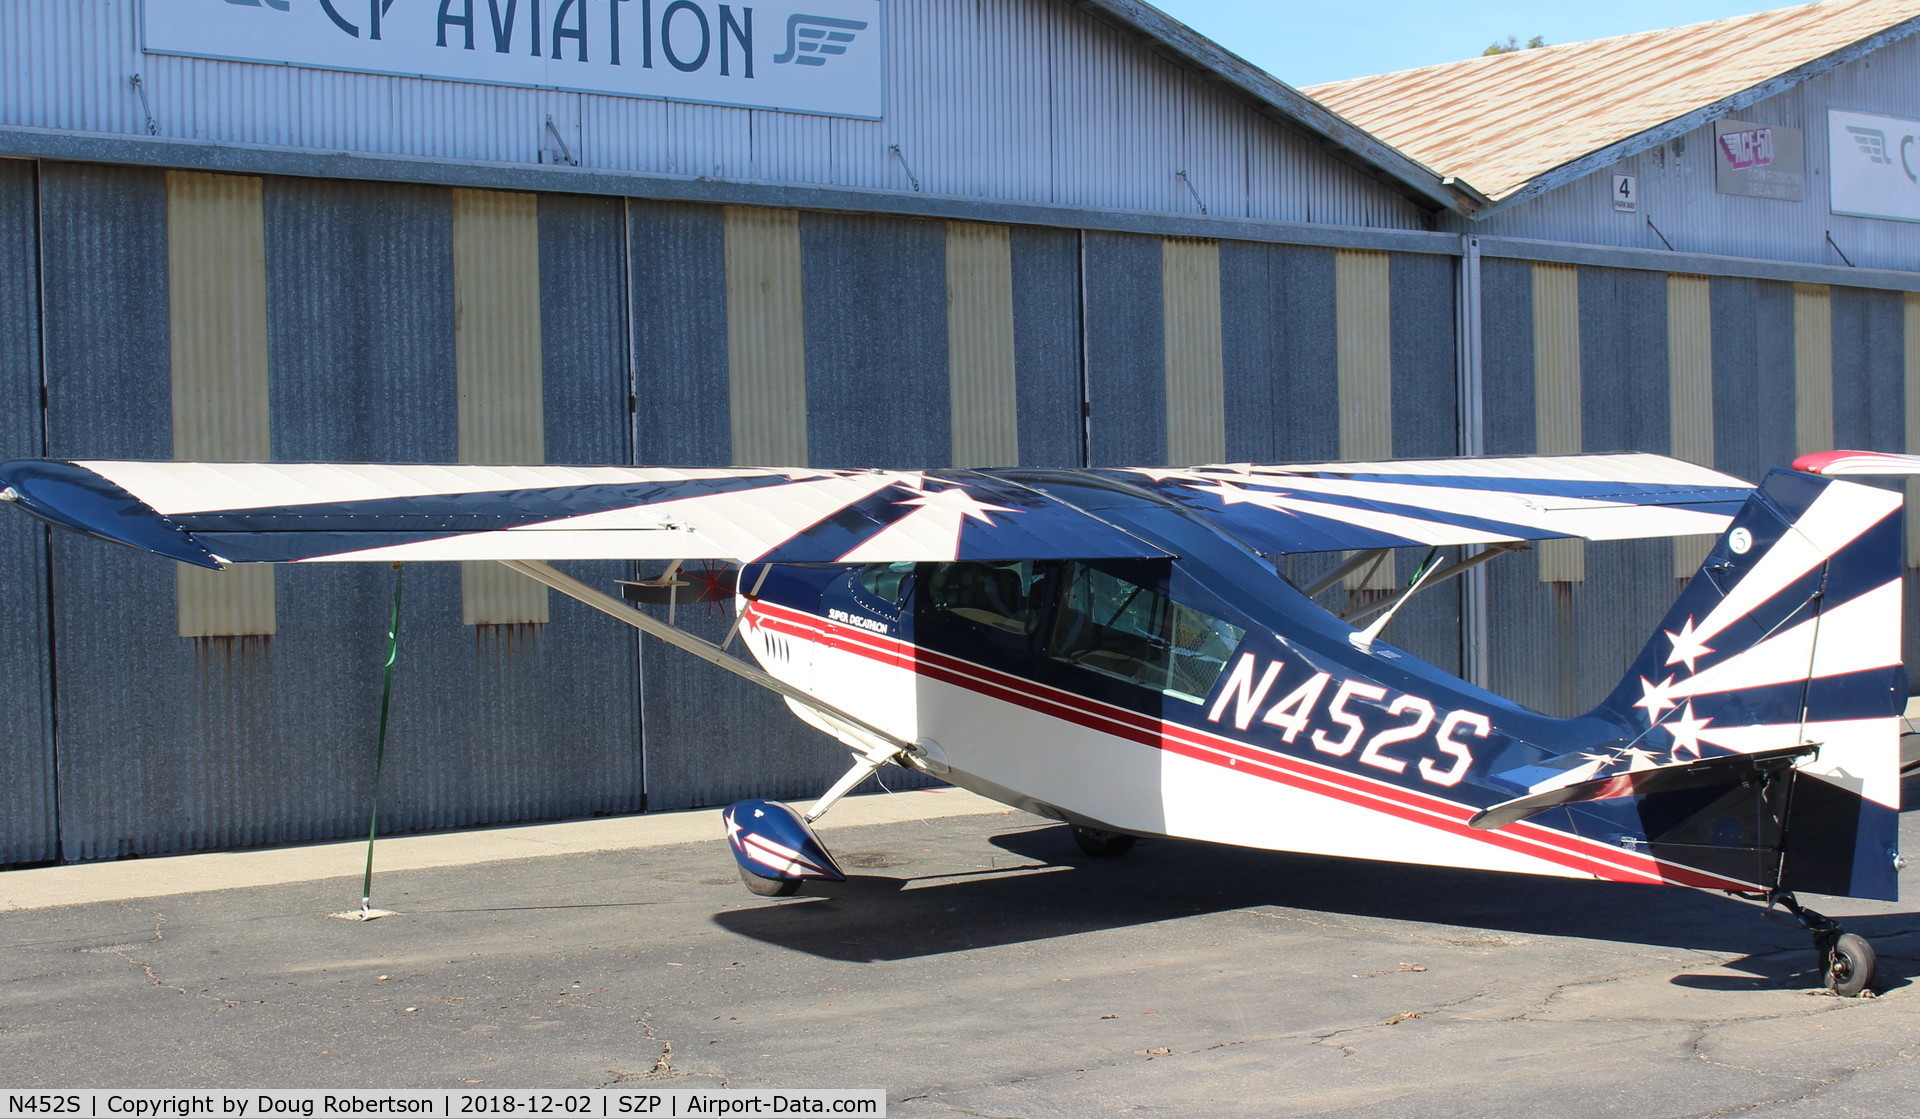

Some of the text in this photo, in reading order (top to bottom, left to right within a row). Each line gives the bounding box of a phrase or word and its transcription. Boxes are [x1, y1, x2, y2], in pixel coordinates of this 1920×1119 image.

[435, 0, 755, 79] AVIATION
[1720, 128, 1773, 168] ACF-50
[1619, 178, 1630, 198] 4
[1735, 531, 1746, 550] 5
[828, 608, 888, 634] SUPER DECATHLON
[1207, 652, 1490, 787] N452S
